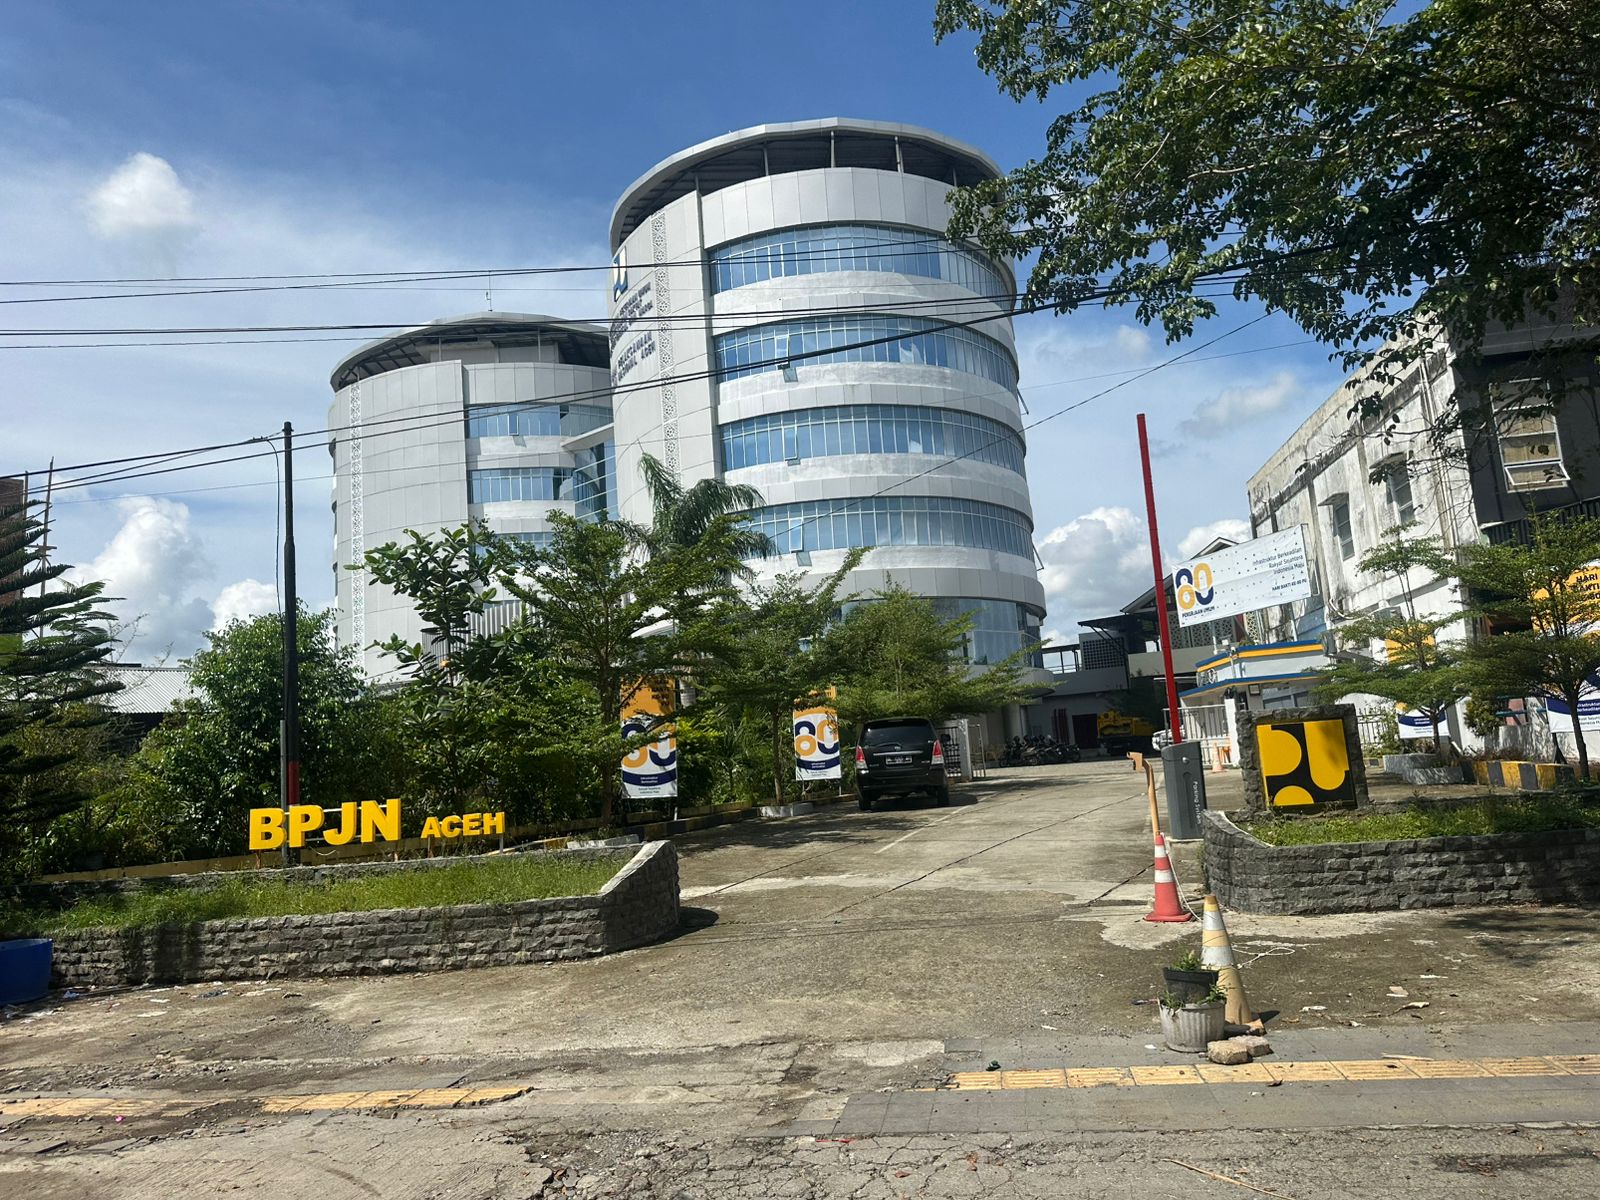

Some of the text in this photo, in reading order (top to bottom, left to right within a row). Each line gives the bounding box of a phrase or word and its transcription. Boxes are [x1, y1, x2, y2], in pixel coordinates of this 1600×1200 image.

[1576, 574, 1598, 582] HARI
[1576, 583, 1600, 592] AKTI
[249, 798, 506, 850] BPJN ACEH
